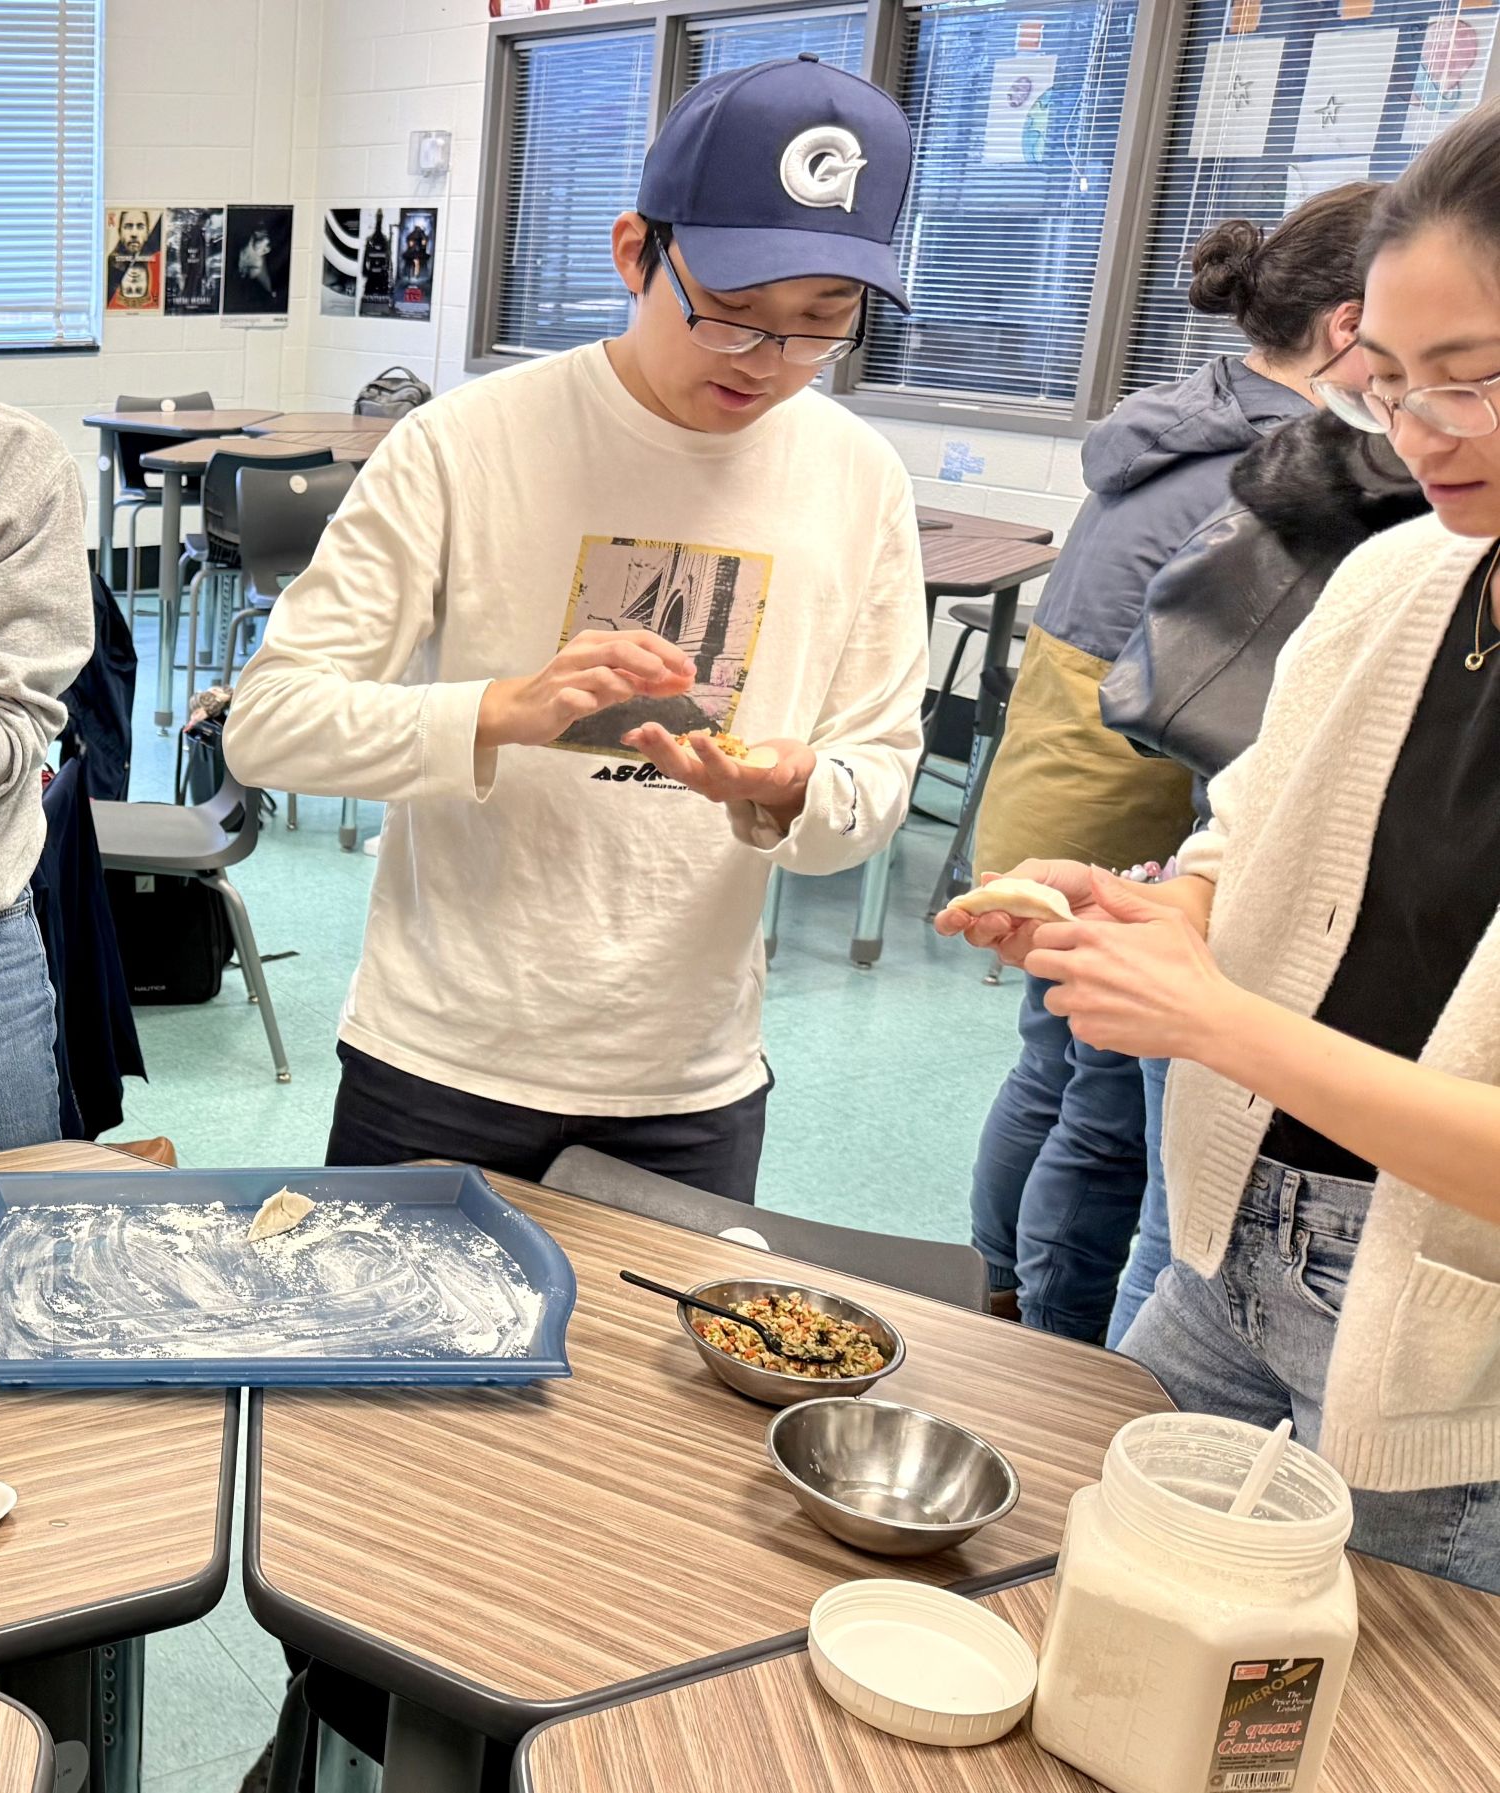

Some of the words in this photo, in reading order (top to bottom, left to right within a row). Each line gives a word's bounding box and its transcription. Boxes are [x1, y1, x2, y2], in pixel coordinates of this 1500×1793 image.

[780, 126, 868, 213] G
[1224, 1720, 1241, 1737] 2
[1245, 1720, 1302, 1740] quart
[1217, 1737, 1303, 1755] Canister
